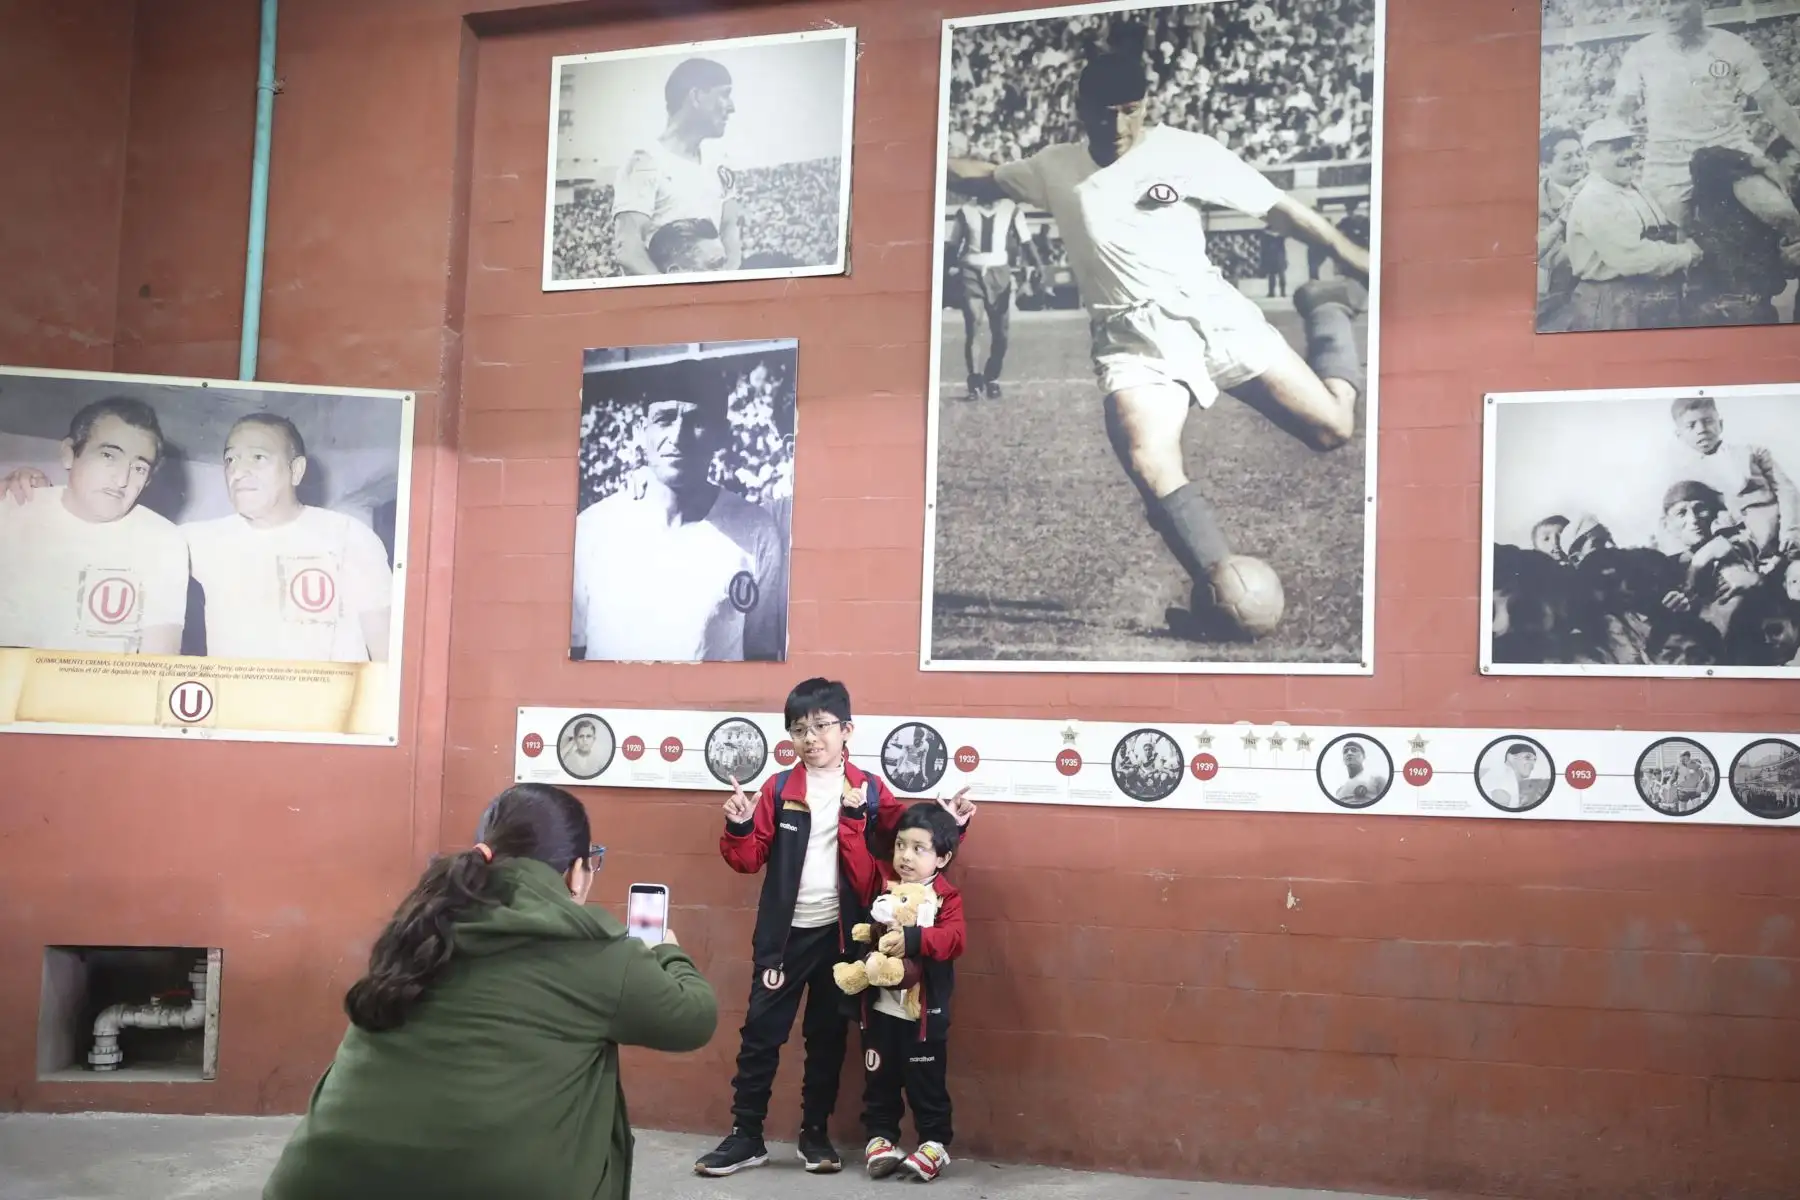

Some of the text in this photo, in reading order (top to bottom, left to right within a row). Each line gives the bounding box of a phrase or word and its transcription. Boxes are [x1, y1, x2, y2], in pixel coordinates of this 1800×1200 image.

[526, 741, 541, 749] 1913
[626, 744, 641, 752] 1920
[664, 745, 680, 753] 1929
[779, 749, 794, 757] 1930
[959, 755, 976, 764] 1932
[1061, 758, 1078, 767] 1935
[1196, 762, 1214, 771] 1939
[1409, 767, 1429, 777] 1949
[1571, 770, 1592, 780] 1953
